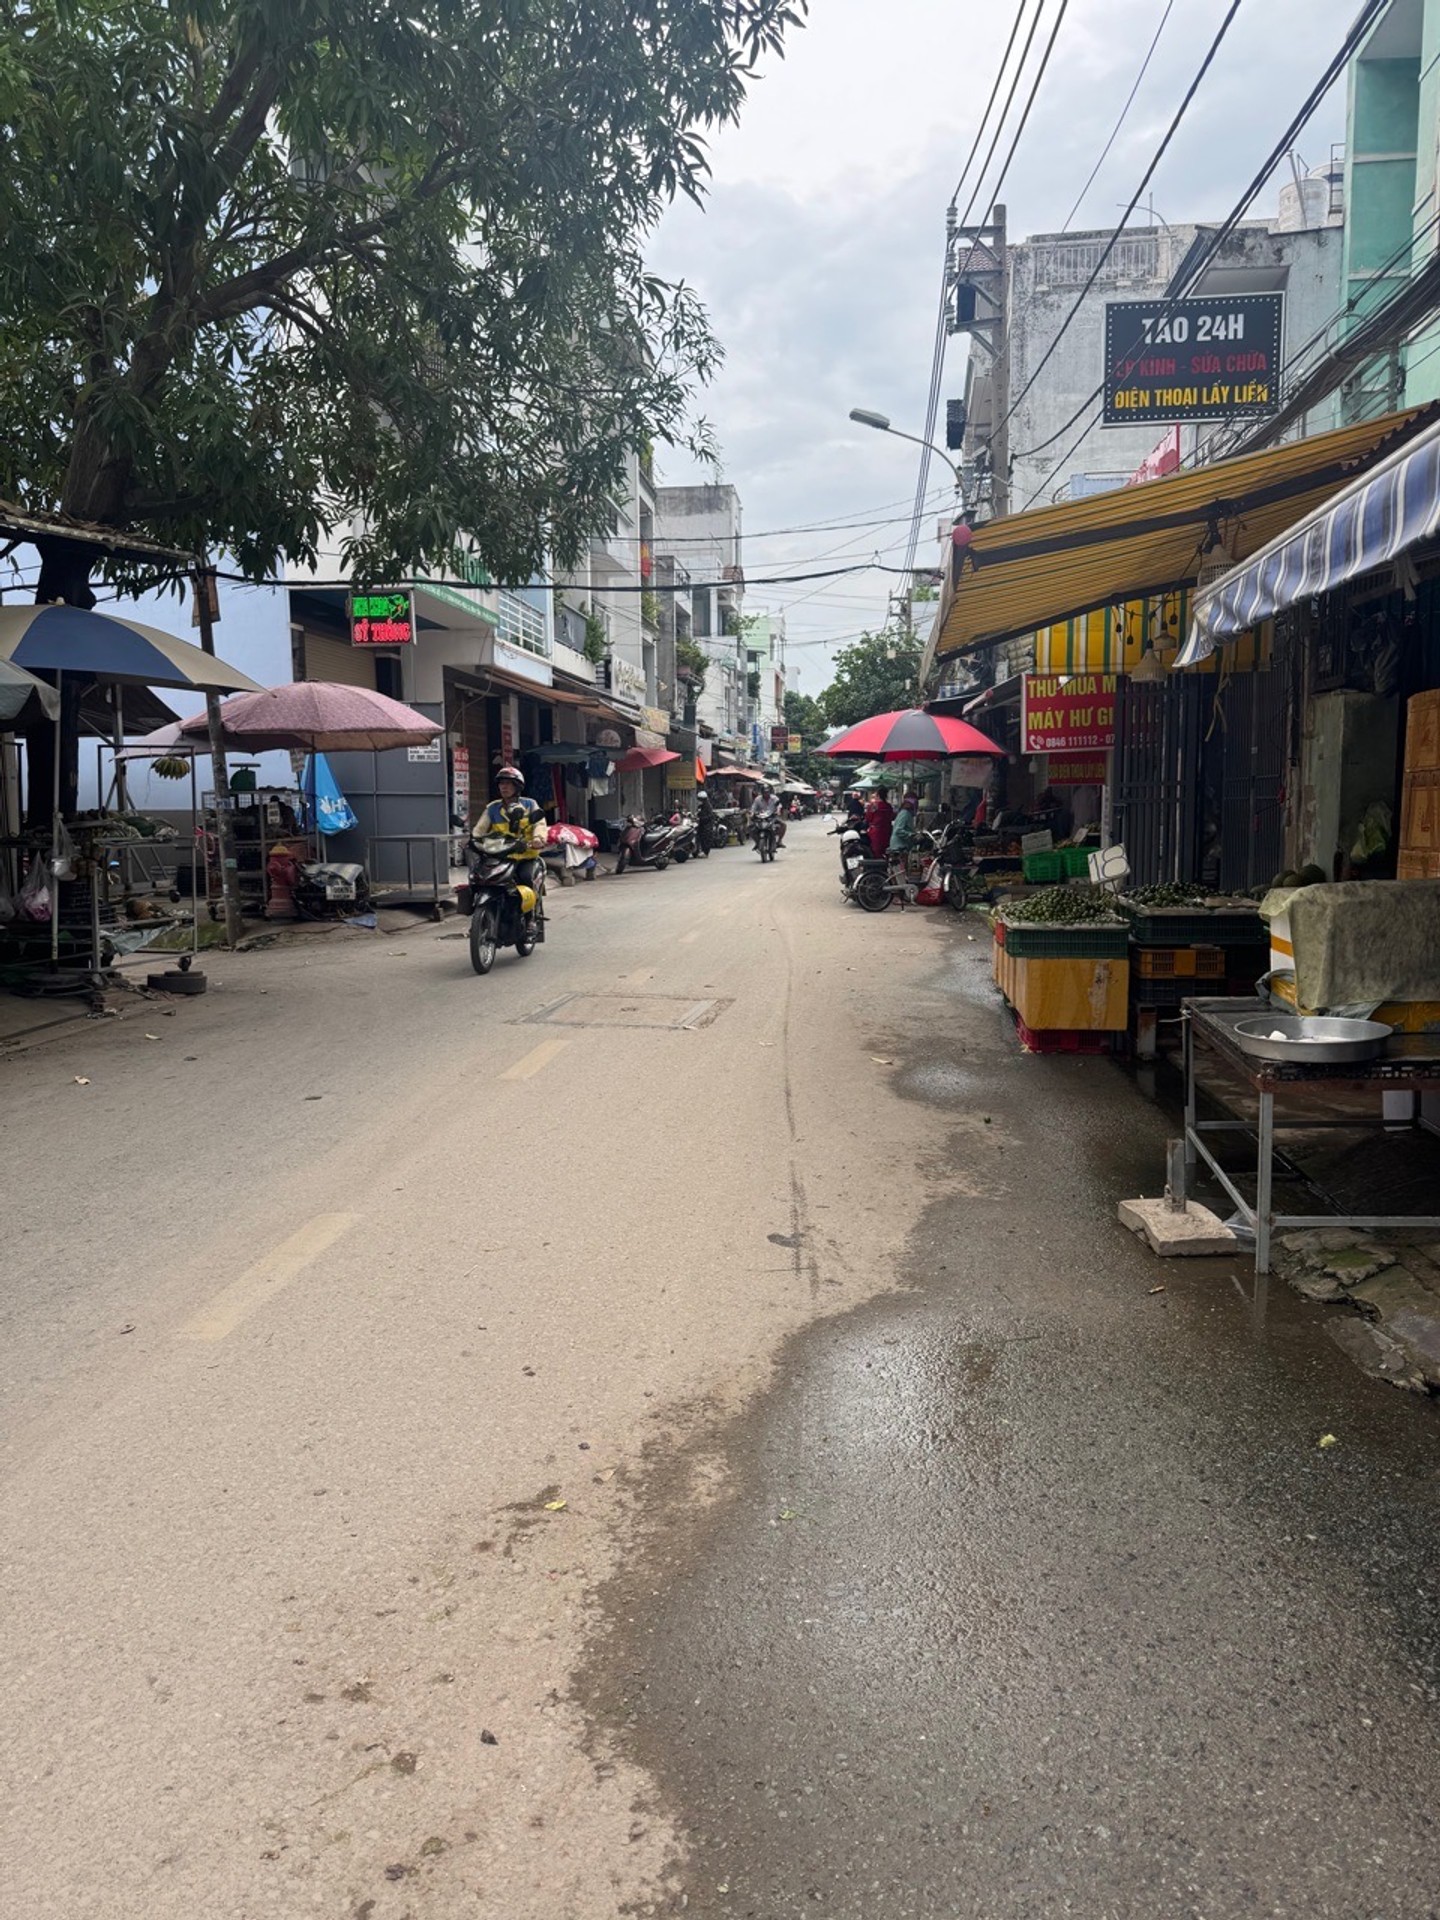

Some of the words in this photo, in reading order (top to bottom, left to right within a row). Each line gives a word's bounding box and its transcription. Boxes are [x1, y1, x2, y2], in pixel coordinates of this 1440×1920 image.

[1142, 312, 1189, 344] TÁO
[1196, 314, 1244, 341] 24H
[1226, 349, 1268, 372] CHỮA
[1114, 386, 1150, 411] ĐIỆN
[1154, 387, 1198, 410] THOẠI
[1202, 379, 1230, 405] LẤY
[1027, 679, 1057, 699] THU
[1062, 675, 1097, 697] MUA
[1028, 706, 1064, 730] MÁY
[1069, 706, 1094, 728] HƯ
[1068, 734, 1098, 747] 111112
[1089, 845, 1128, 880] 18
